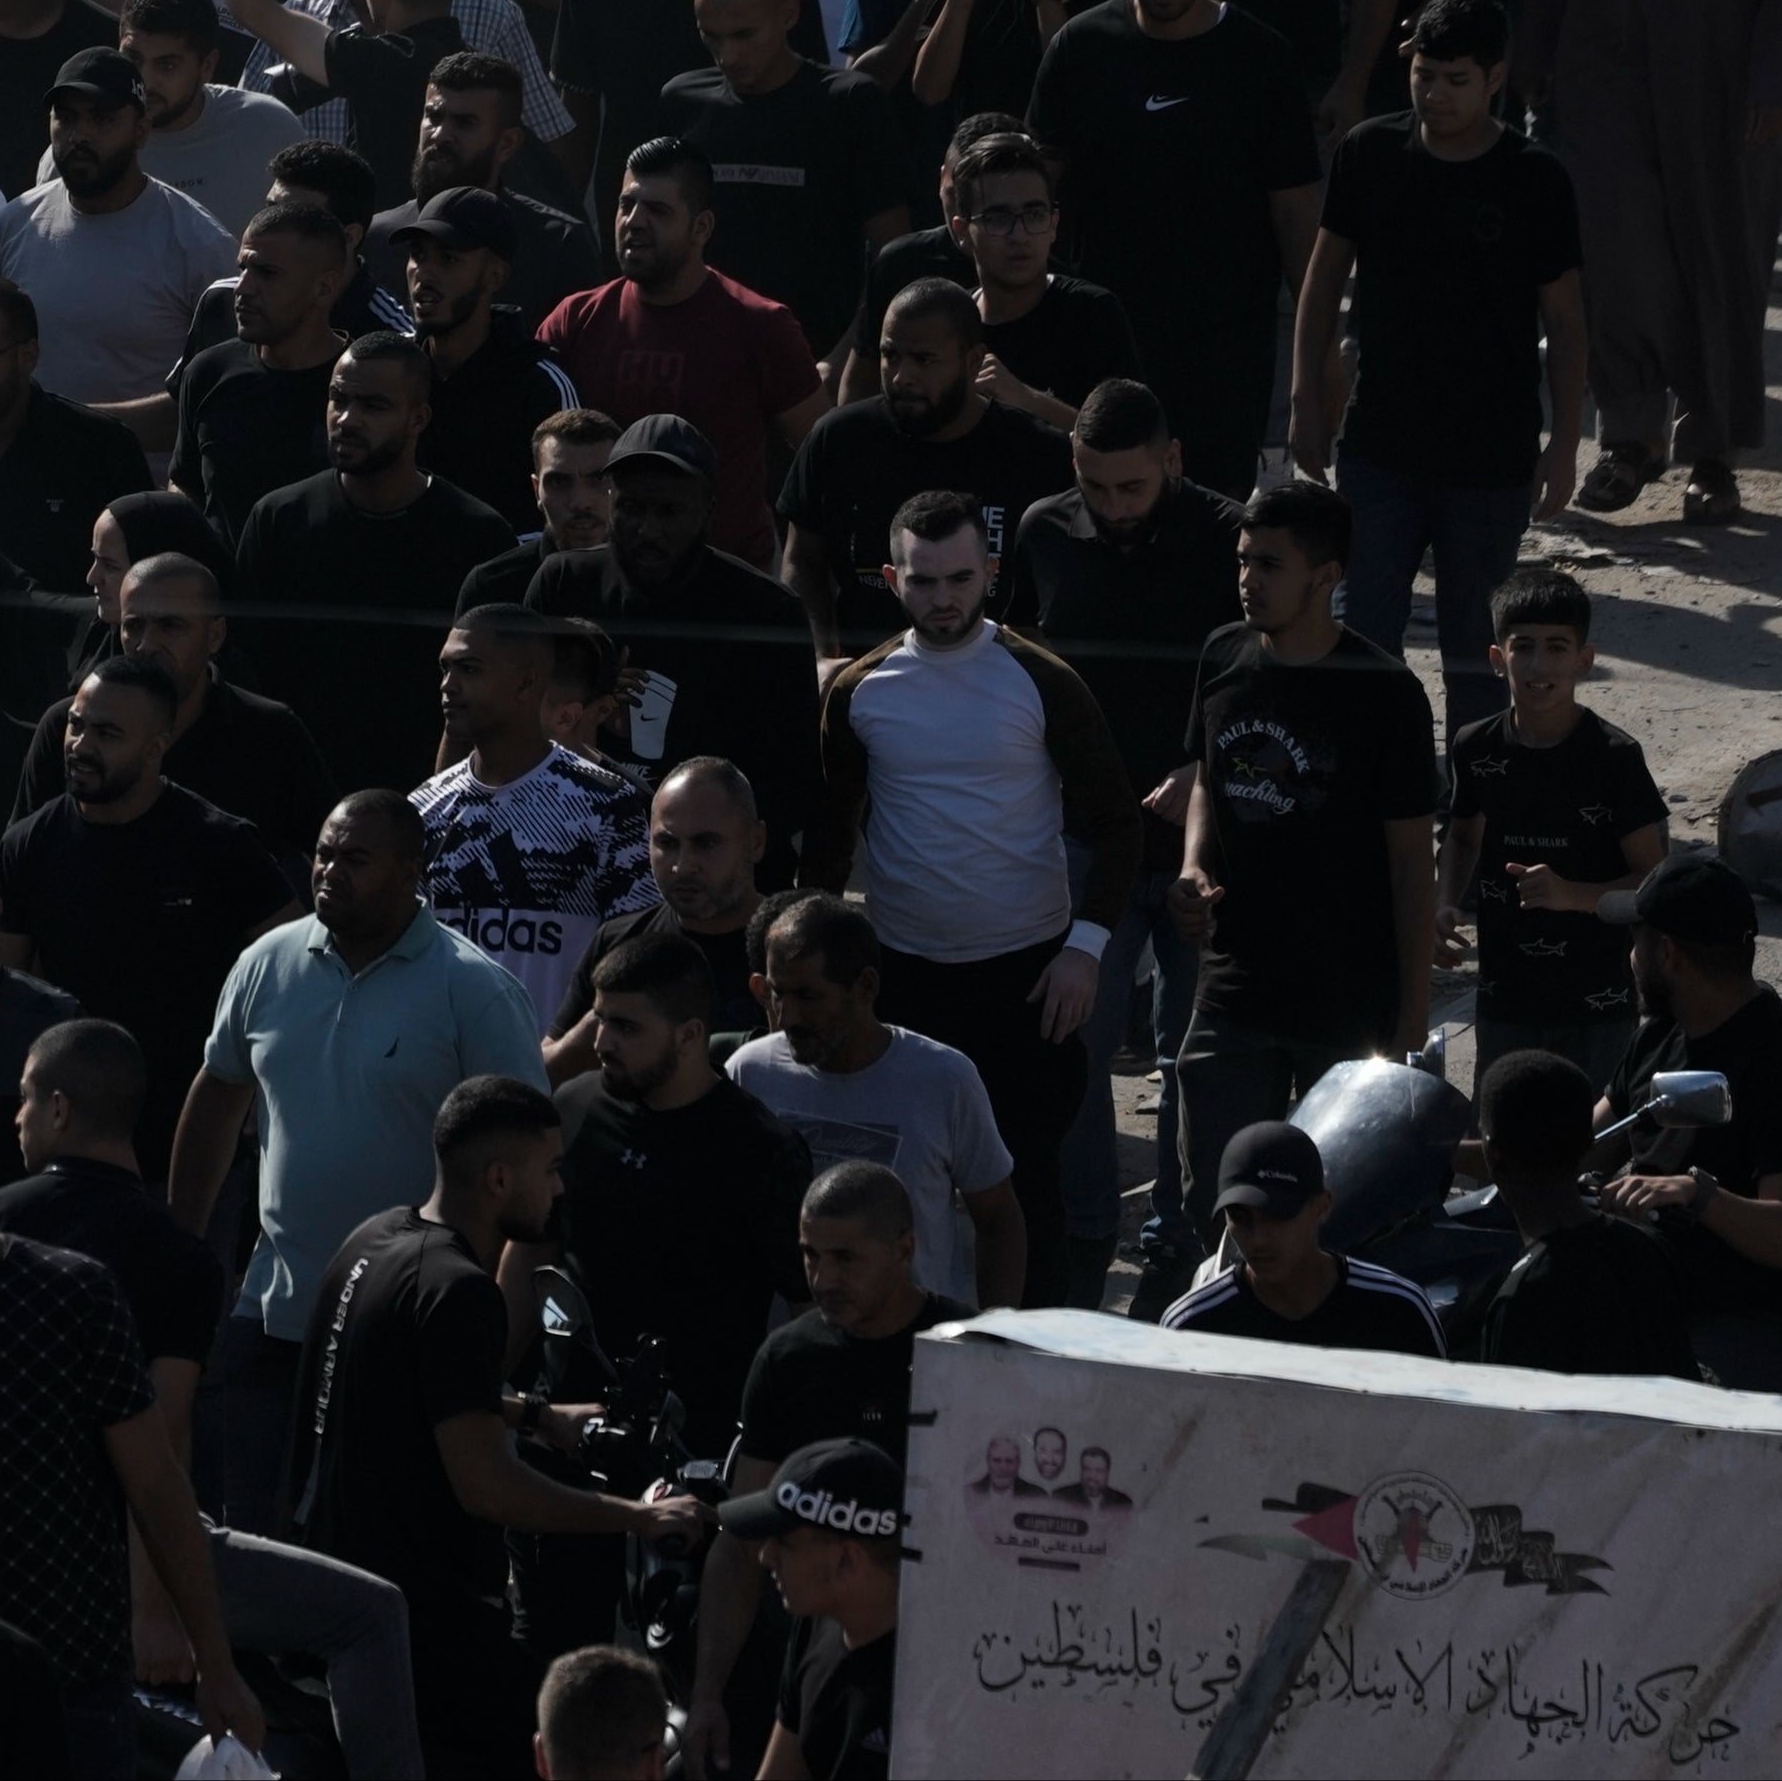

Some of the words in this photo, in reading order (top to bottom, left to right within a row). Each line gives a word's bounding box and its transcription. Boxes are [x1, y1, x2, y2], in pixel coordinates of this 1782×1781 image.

[1217, 721, 1251, 750] PAUL
[1252, 719, 1267, 734] &
[1265, 721, 1311, 775] SHARK
[1504, 834, 1527, 846] PAUL
[1528, 836, 1536, 847] &
[1537, 836, 1569, 848] SHARK
[436, 895, 564, 956] didas
[333, 1258, 369, 1333] UNDER
[313, 1338, 339, 1435] ARMOUR
[777, 1480, 898, 1536] adidas
[975, 1601, 1162, 1691] فلسطين
[1171, 1627, 1241, 1728] في
[1470, 1645, 1602, 1754] الجهاد
[1609, 1665, 1741, 1765] حركة
